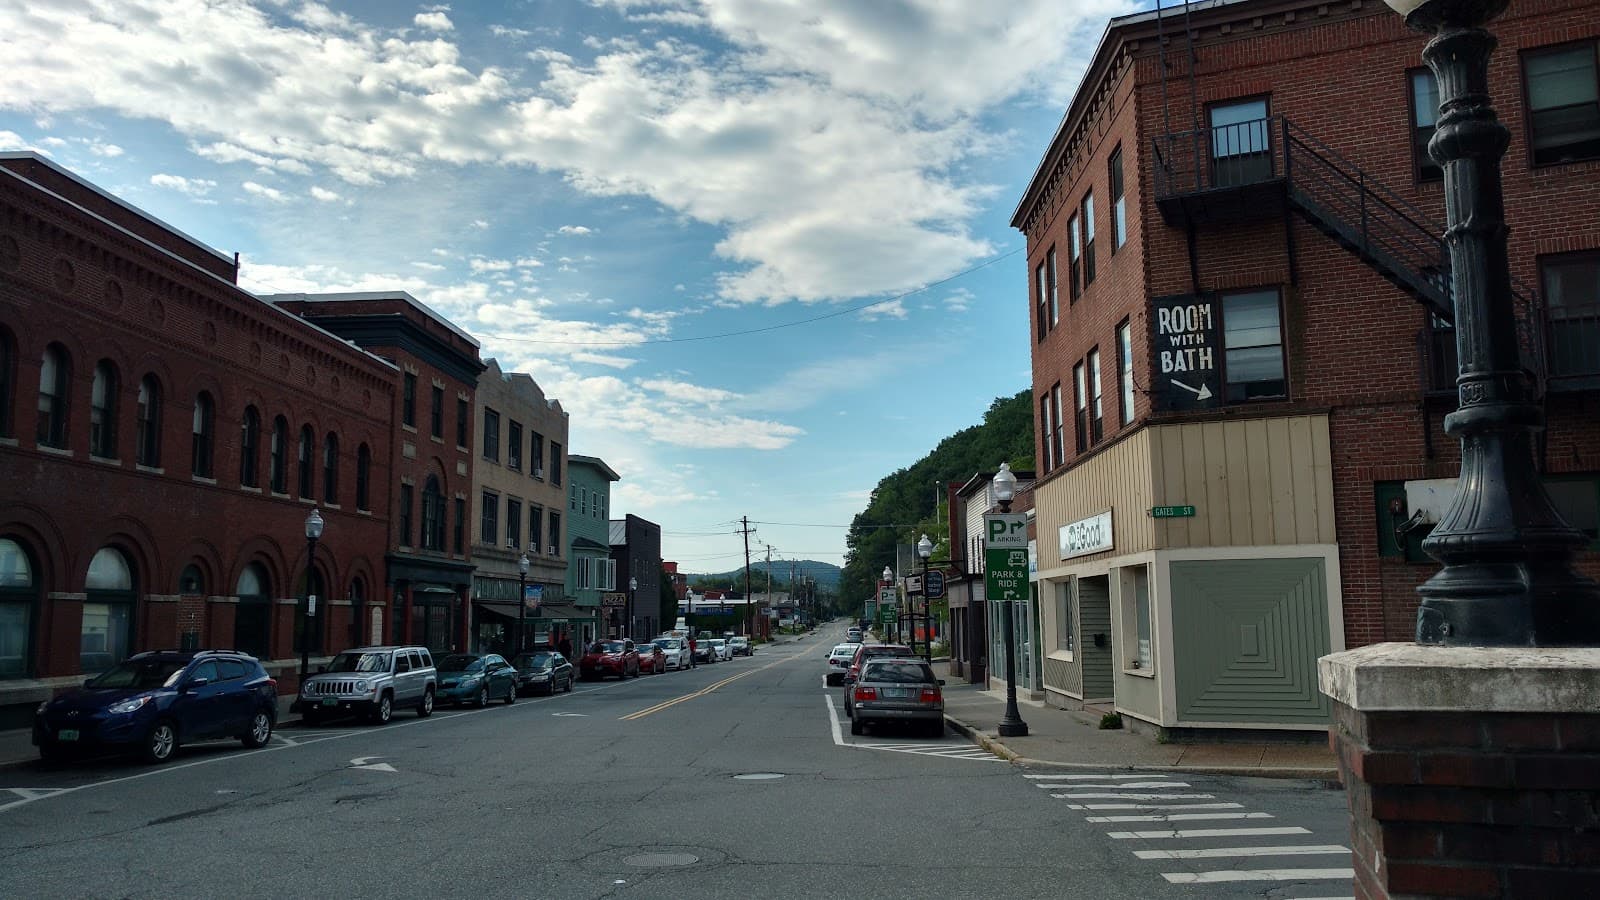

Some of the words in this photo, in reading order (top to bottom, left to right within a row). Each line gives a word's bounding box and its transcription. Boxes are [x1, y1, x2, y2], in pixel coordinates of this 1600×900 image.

[1158, 303, 1212, 334] ROOM
[1169, 333, 1204, 347] WITH
[1160, 347, 1213, 373] BATH
[1155, 507, 1174, 516] GATES
[1183, 507, 1192, 515] ST
[991, 570, 1014, 578] PARK
[1017, 570, 1024, 578] &
[998, 580, 1018, 588] RIDE
